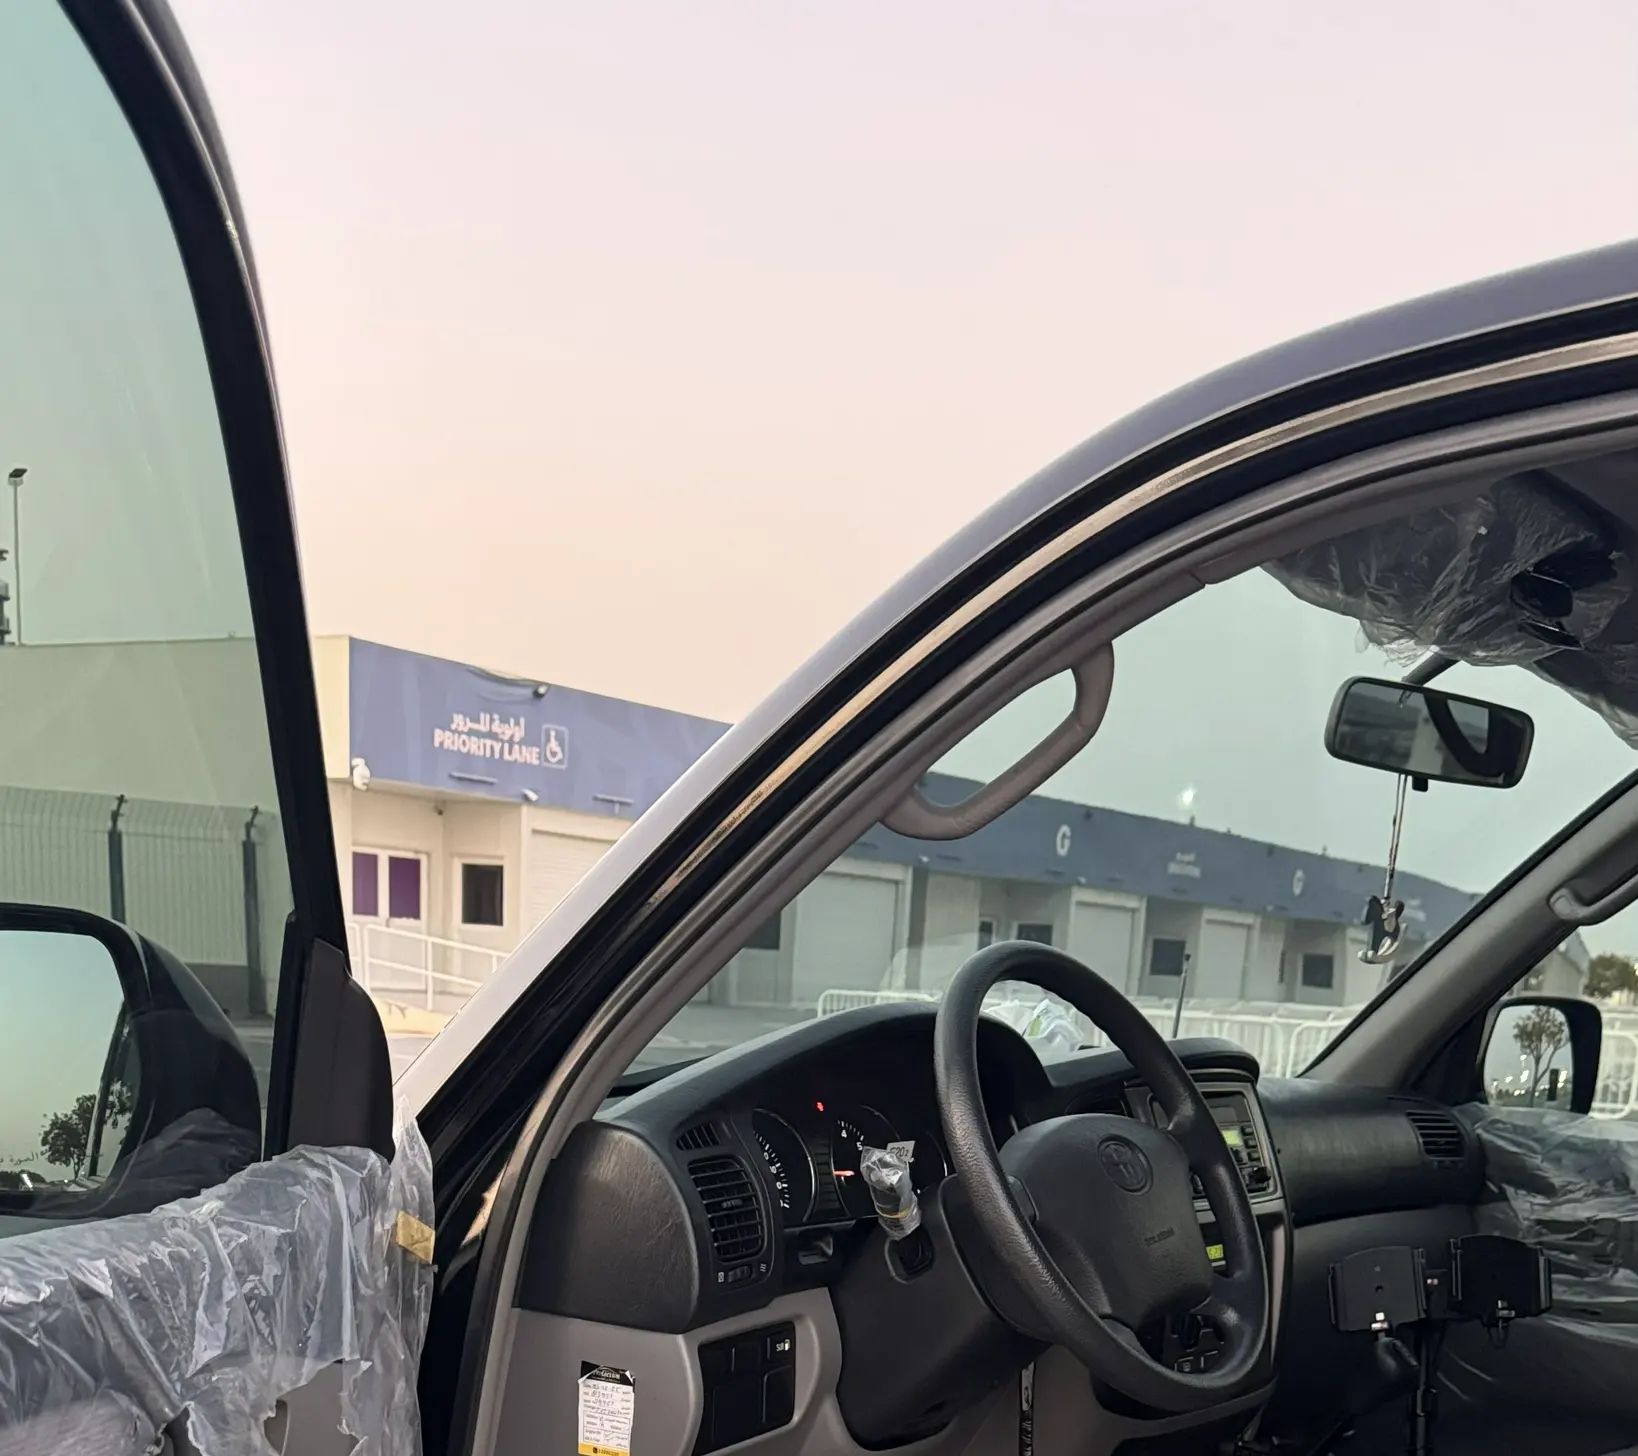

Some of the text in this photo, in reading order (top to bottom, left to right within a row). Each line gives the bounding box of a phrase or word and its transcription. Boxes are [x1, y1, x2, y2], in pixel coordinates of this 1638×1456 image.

[433, 728, 540, 766] PRIORITY LANE
[1055, 824, 1071, 857] G
[856, 1142, 863, 1151] 5
